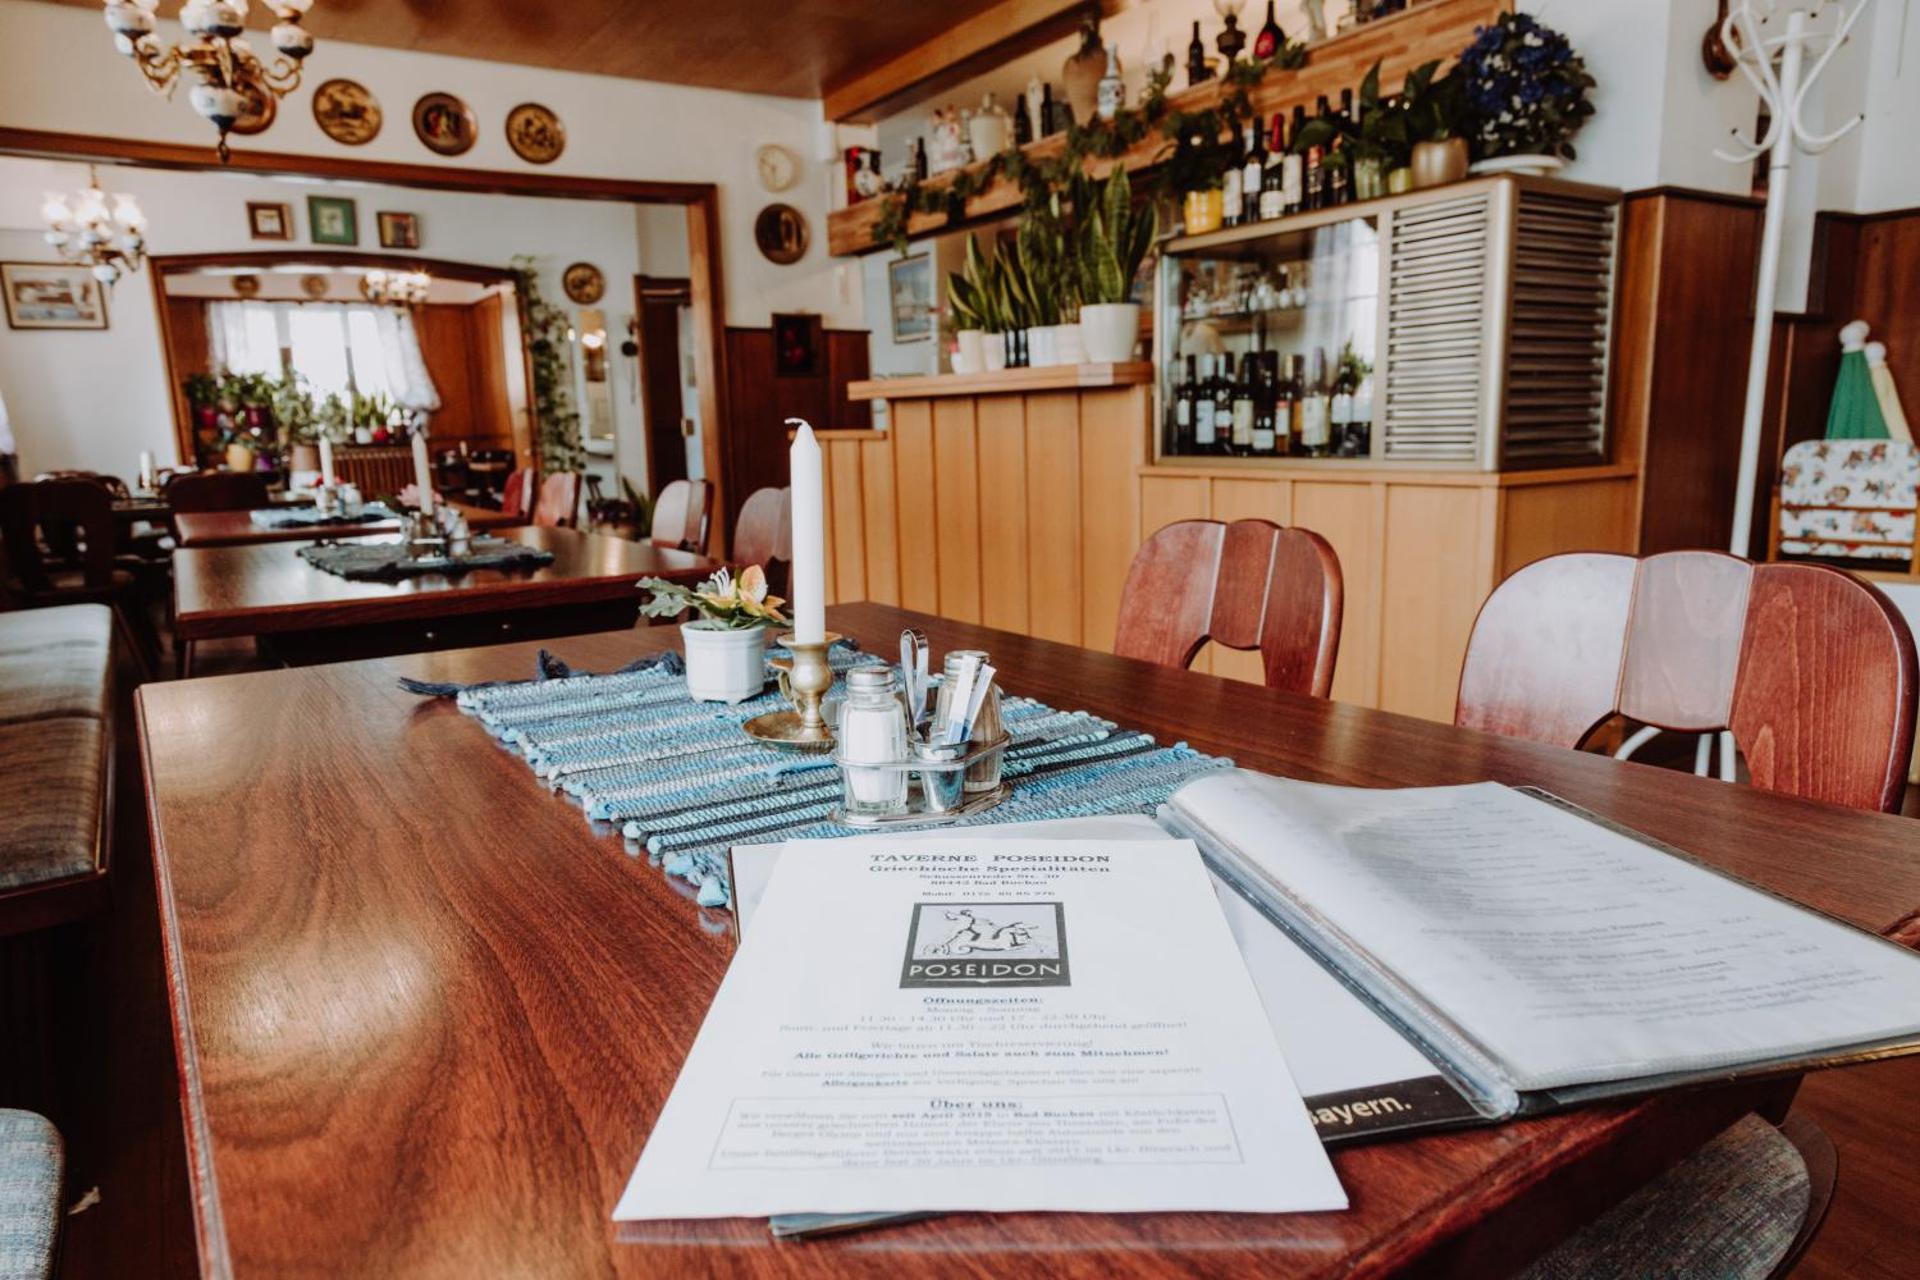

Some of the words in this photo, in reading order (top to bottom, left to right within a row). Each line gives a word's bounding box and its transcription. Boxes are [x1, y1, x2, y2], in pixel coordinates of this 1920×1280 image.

[870, 854, 978, 863] TAVERNE
[992, 854, 1110, 863] POSEIDON
[869, 865, 980, 873] Griechische
[986, 865, 1111, 874] Spezialitäten
[909, 963, 1060, 977] POSEIDON
[923, 996, 1044, 1005] Öffnungszeiten:
[826, 1051, 918, 1060] Grillgerichte
[1004, 1050, 1039, 1058] auch
[1080, 1048, 1169, 1058] Mitnehmen!
[928, 1099, 975, 1110] Über
[981, 1100, 1024, 1110] uns:
